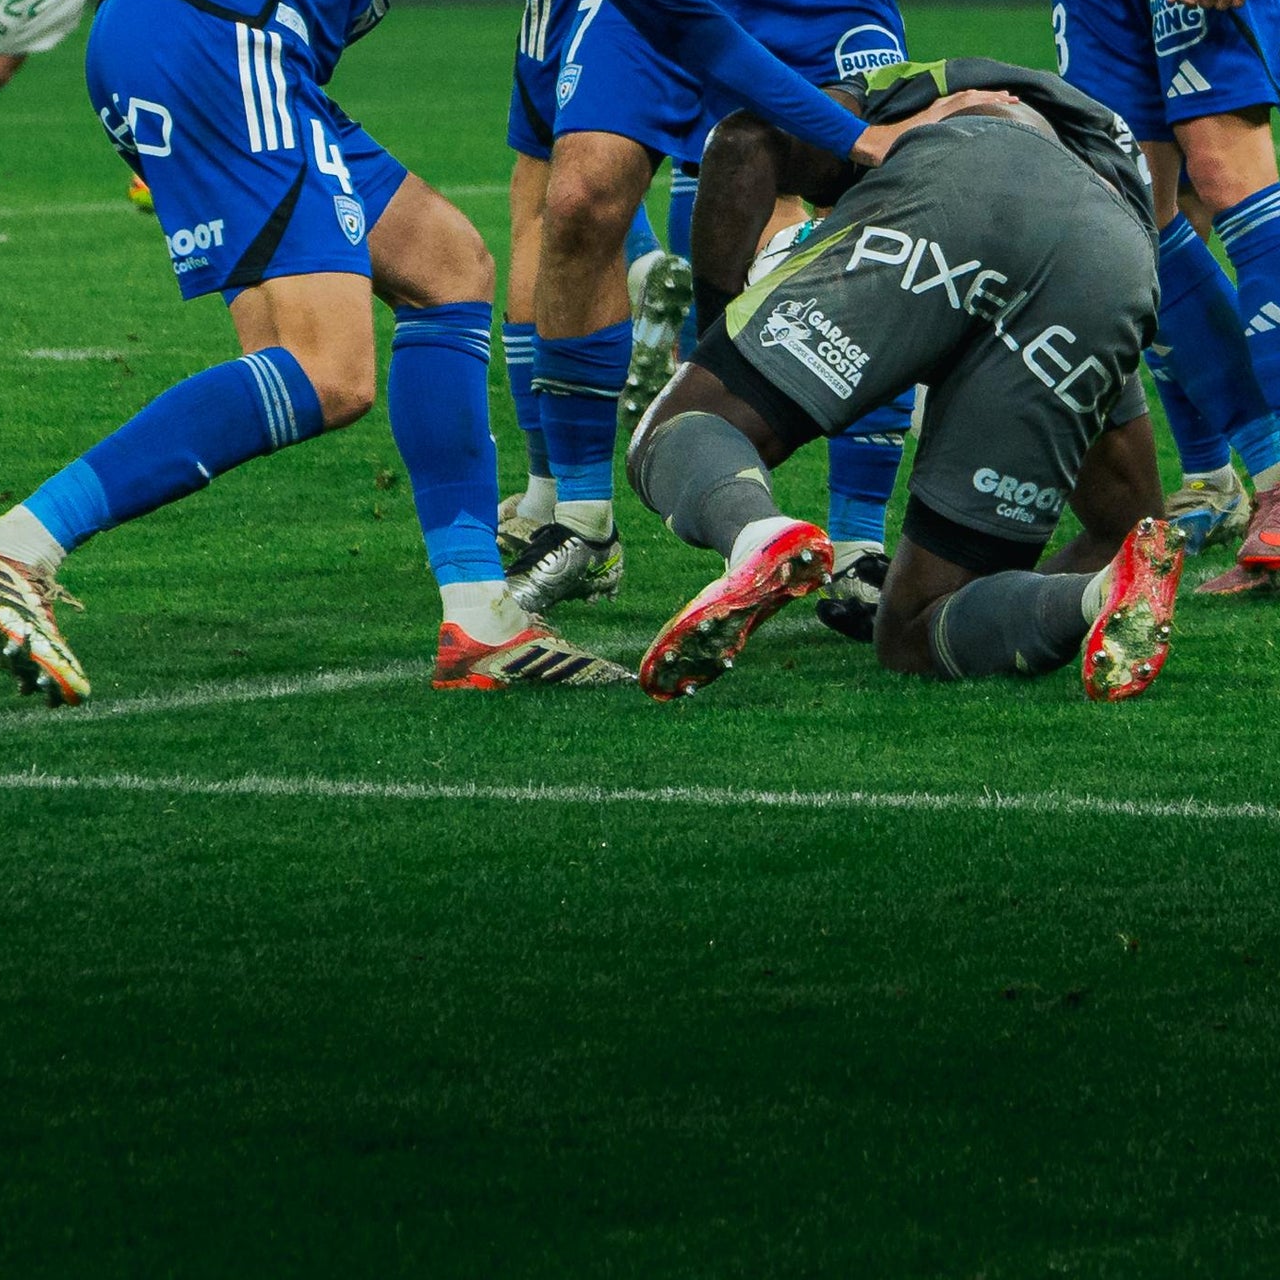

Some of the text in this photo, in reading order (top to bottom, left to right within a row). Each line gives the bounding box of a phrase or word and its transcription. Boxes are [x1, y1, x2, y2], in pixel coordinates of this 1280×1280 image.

[165, 219, 224, 259] OOT
[808, 310, 871, 369] GARAGE
[817, 341, 863, 388] COSTA
